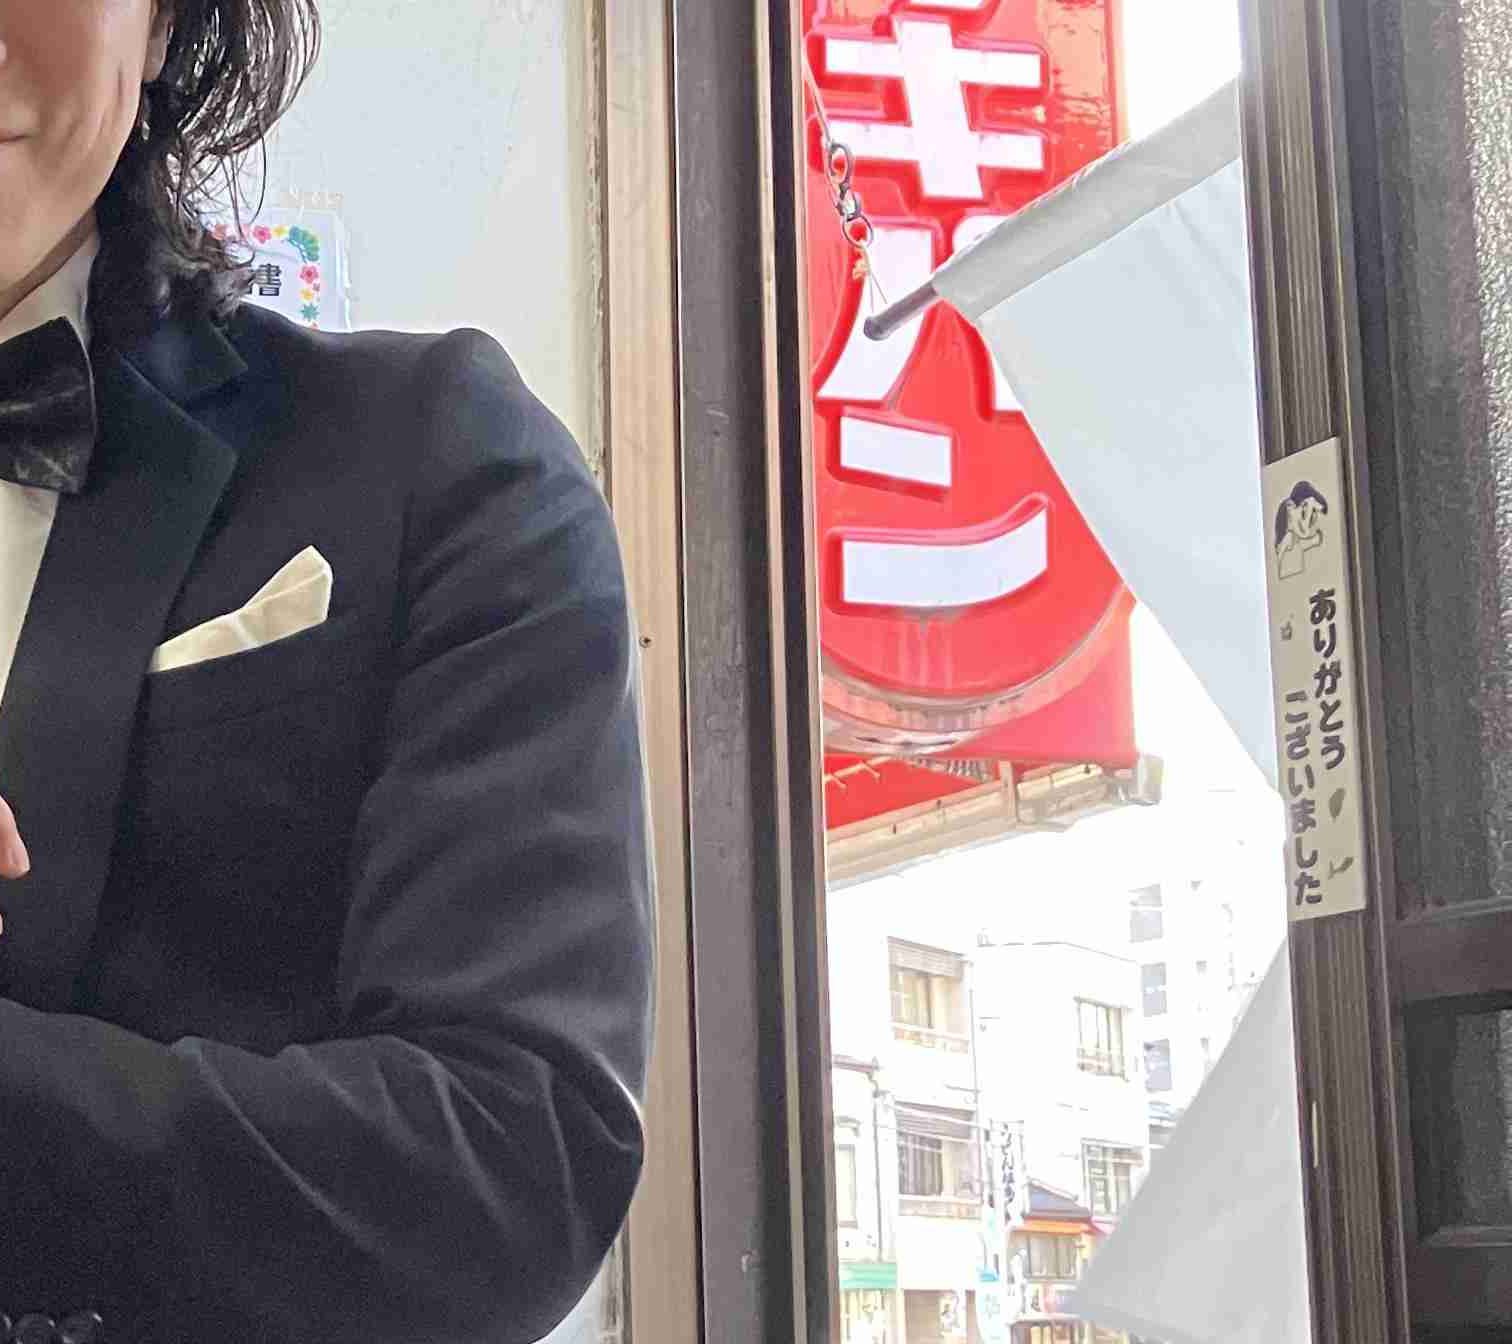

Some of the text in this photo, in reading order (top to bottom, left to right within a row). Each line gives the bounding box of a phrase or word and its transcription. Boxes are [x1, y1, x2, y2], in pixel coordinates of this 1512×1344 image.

[1308, 588, 1346, 771] ありがとう
